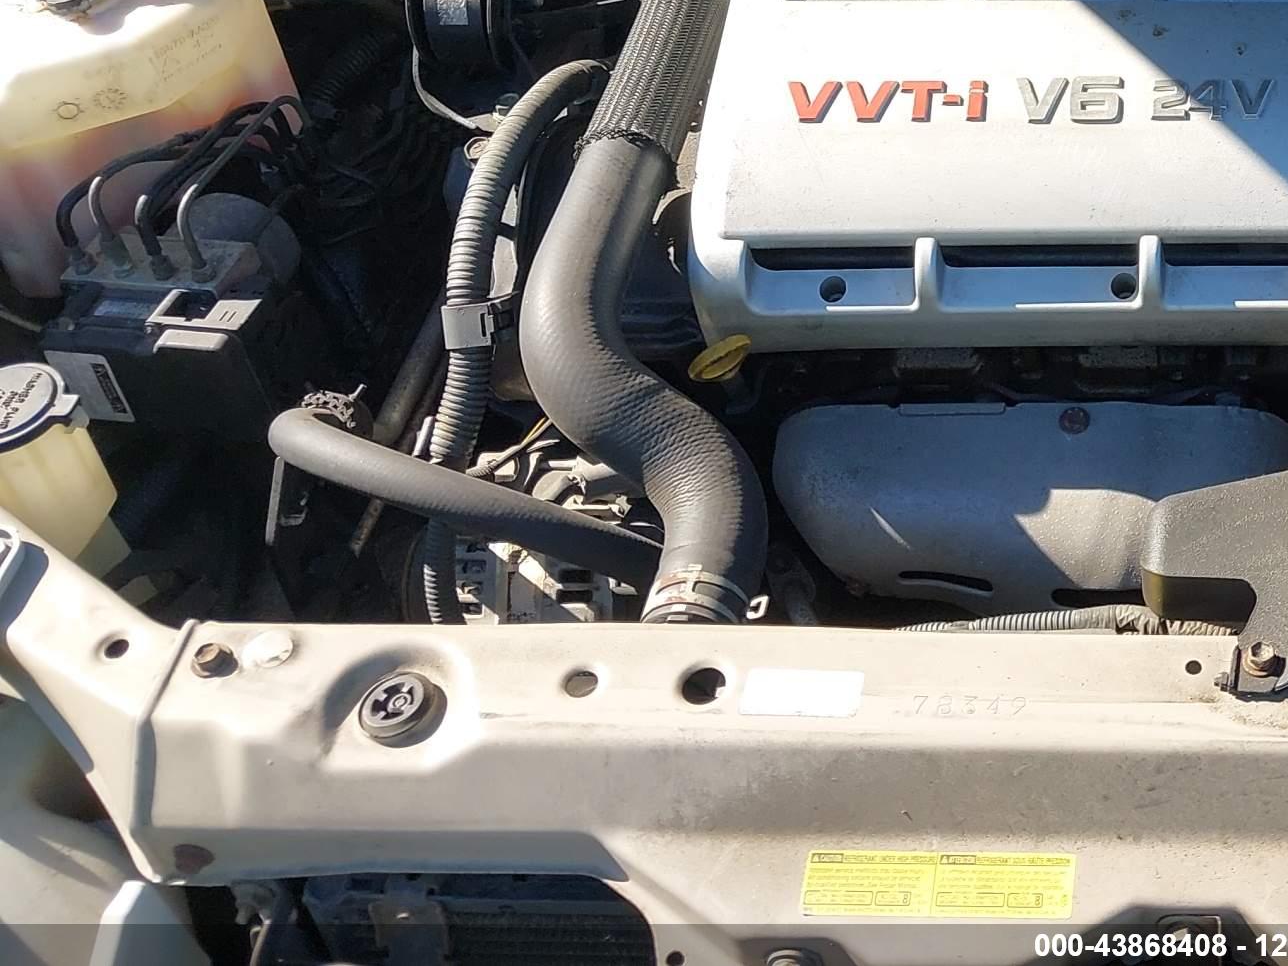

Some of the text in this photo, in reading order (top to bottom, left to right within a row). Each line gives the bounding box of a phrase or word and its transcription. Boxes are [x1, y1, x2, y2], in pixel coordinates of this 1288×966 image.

[788, 76, 1276, 124] VVT-i V6 24V
